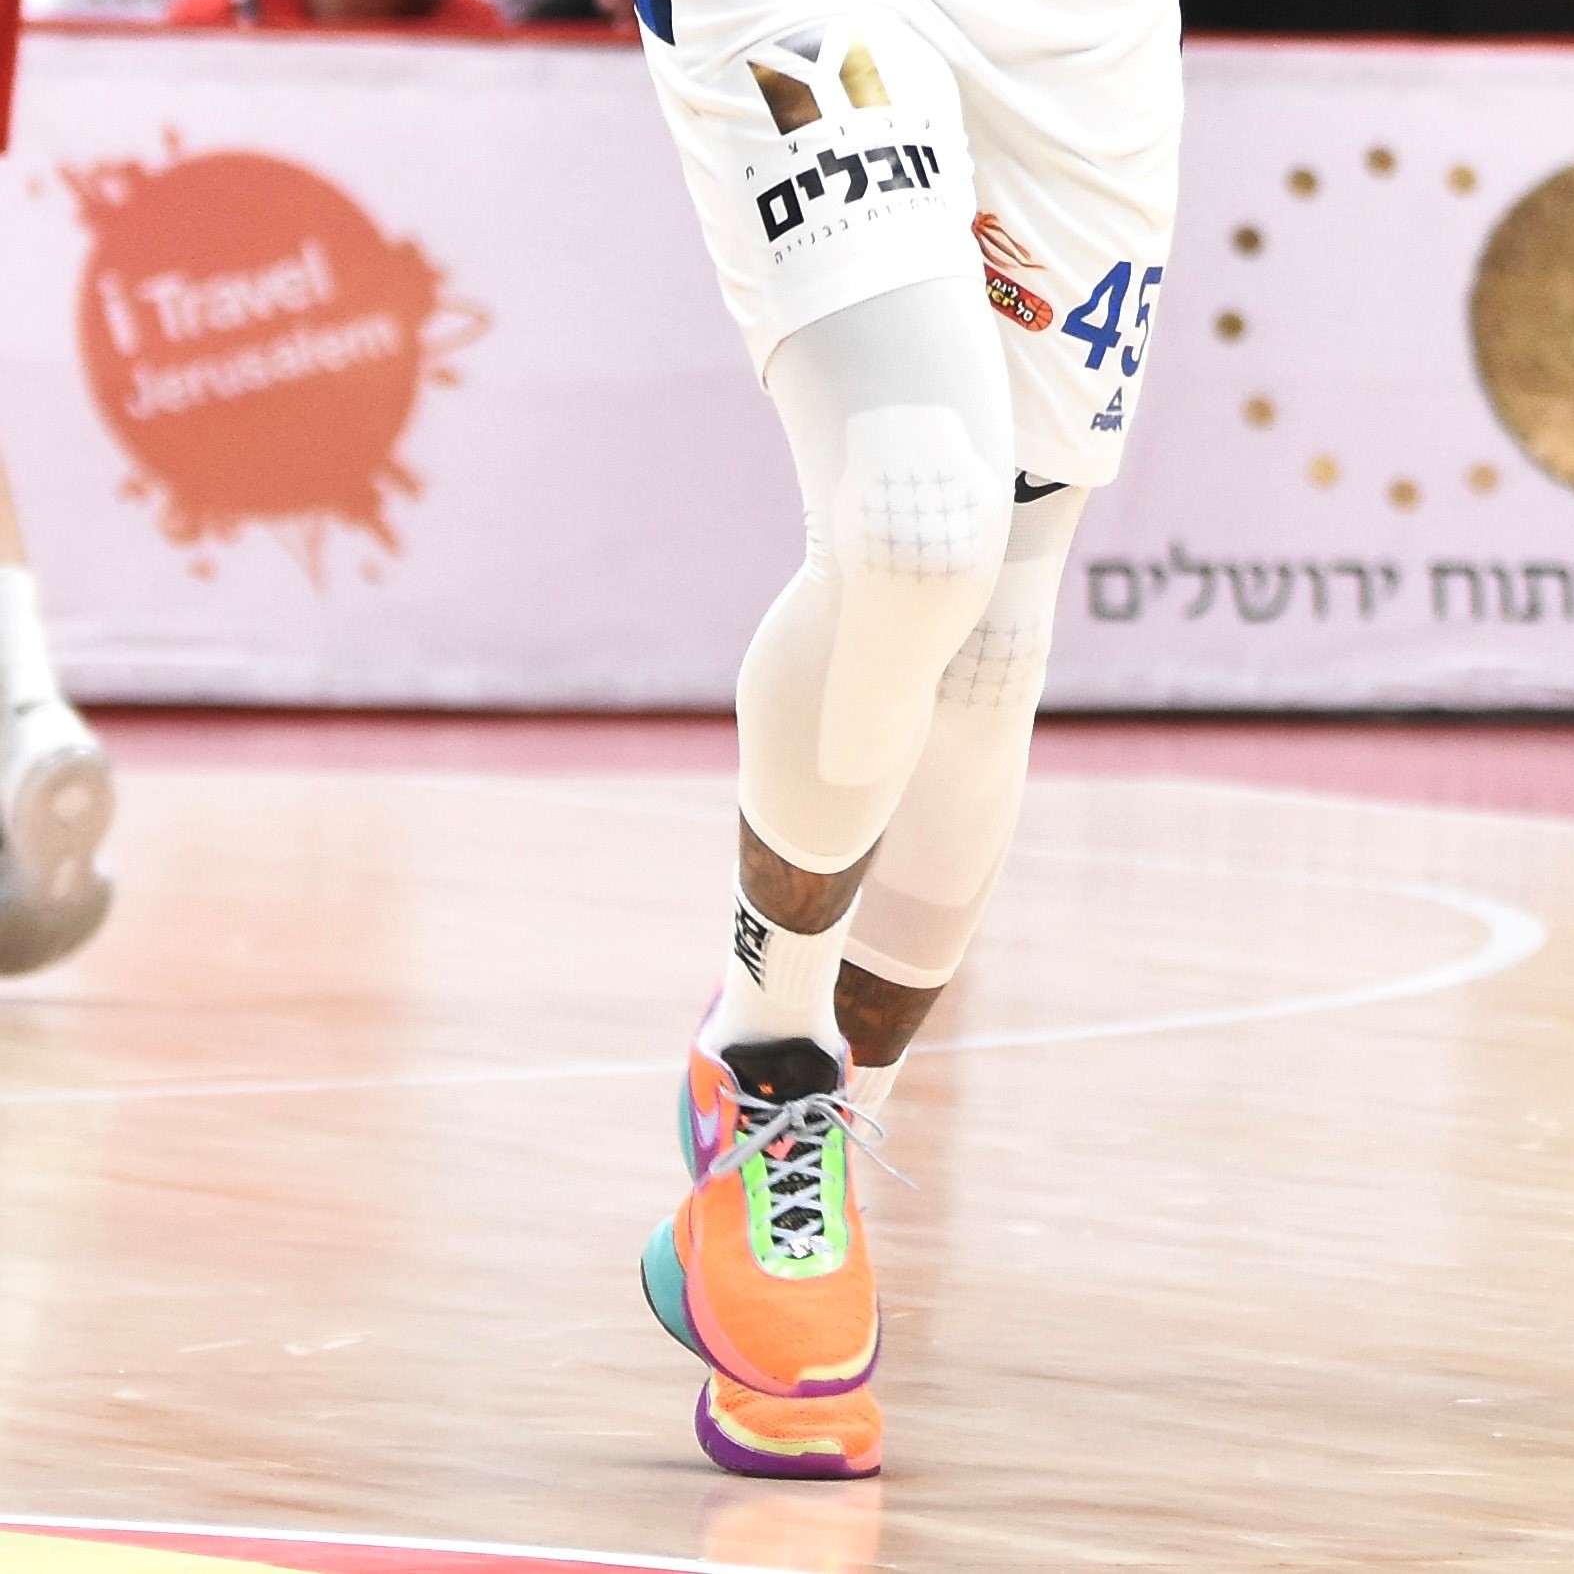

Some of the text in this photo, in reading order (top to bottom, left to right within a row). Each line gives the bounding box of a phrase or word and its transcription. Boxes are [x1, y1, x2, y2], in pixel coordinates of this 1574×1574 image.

[756, 144, 941, 243] יובלים
[135, 237, 335, 341] Travel
[1015, 301, 1034, 322] סל
[1060, 260, 1164, 377] 45
[125, 315, 401, 420] Jerusalem
[1088, 538, 1401, 624] ירושלים
